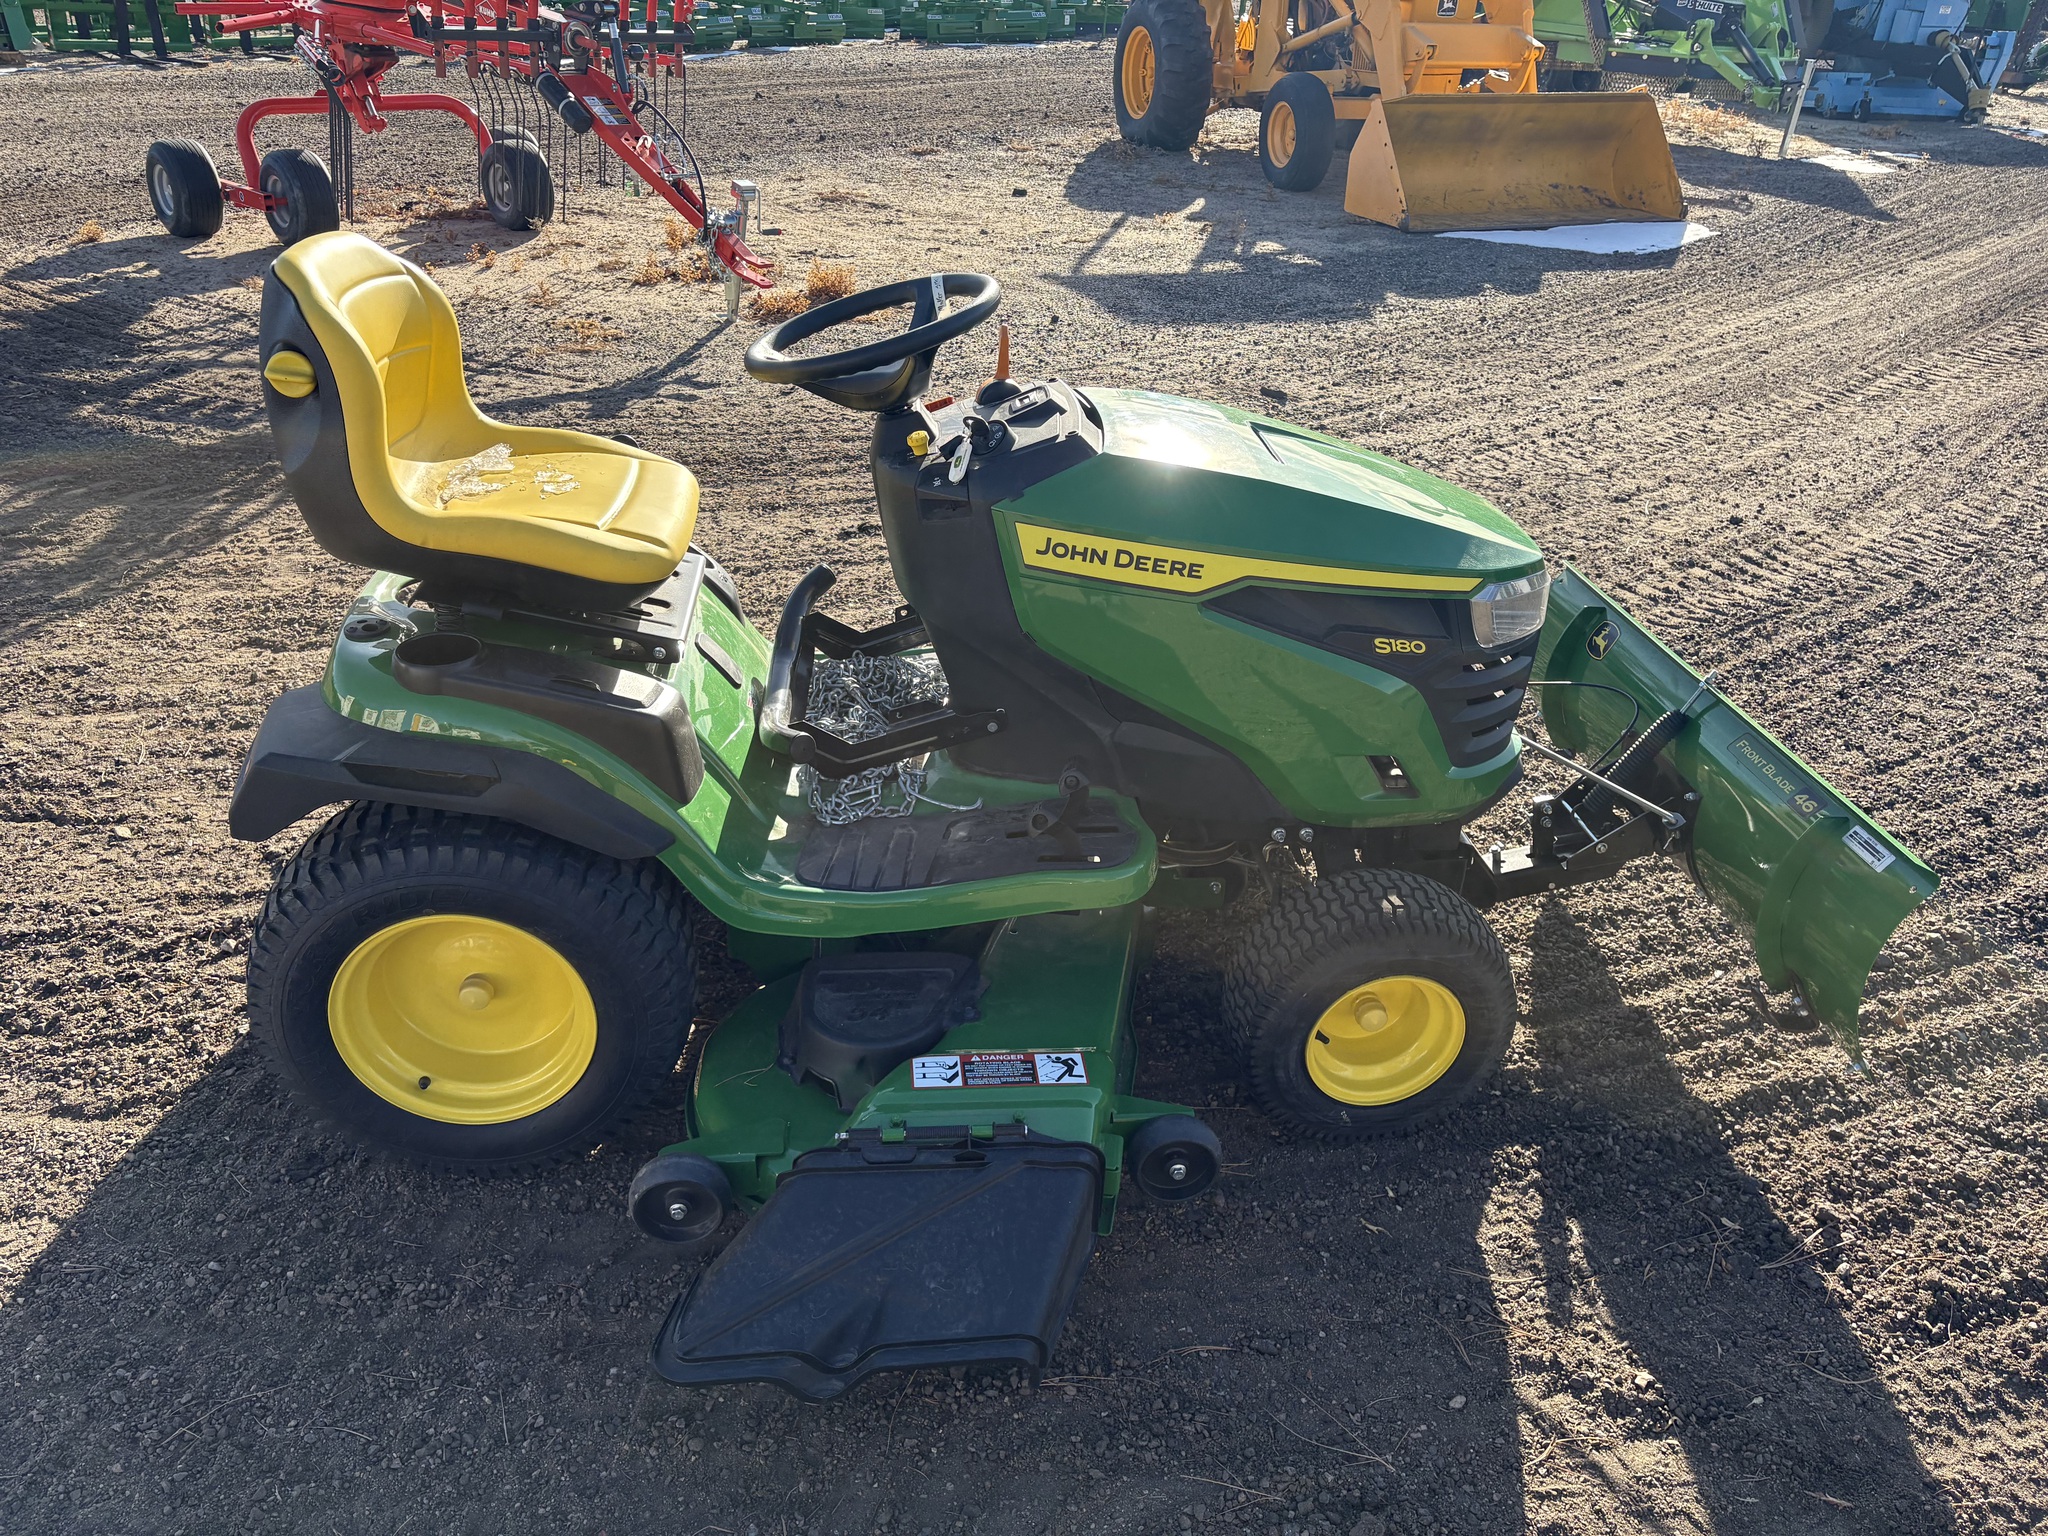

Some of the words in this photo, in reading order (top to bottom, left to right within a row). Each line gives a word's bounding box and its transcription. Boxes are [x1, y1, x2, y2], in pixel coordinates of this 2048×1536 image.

[478, 5, 496, 19] KUHN
[1687, 0, 1724, 14] SHULTE
[1035, 537, 1108, 566] JOHN
[1114, 548, 1205, 580] DEERE
[1374, 637, 1427, 654] S180
[1793, 794, 1818, 813] 46
